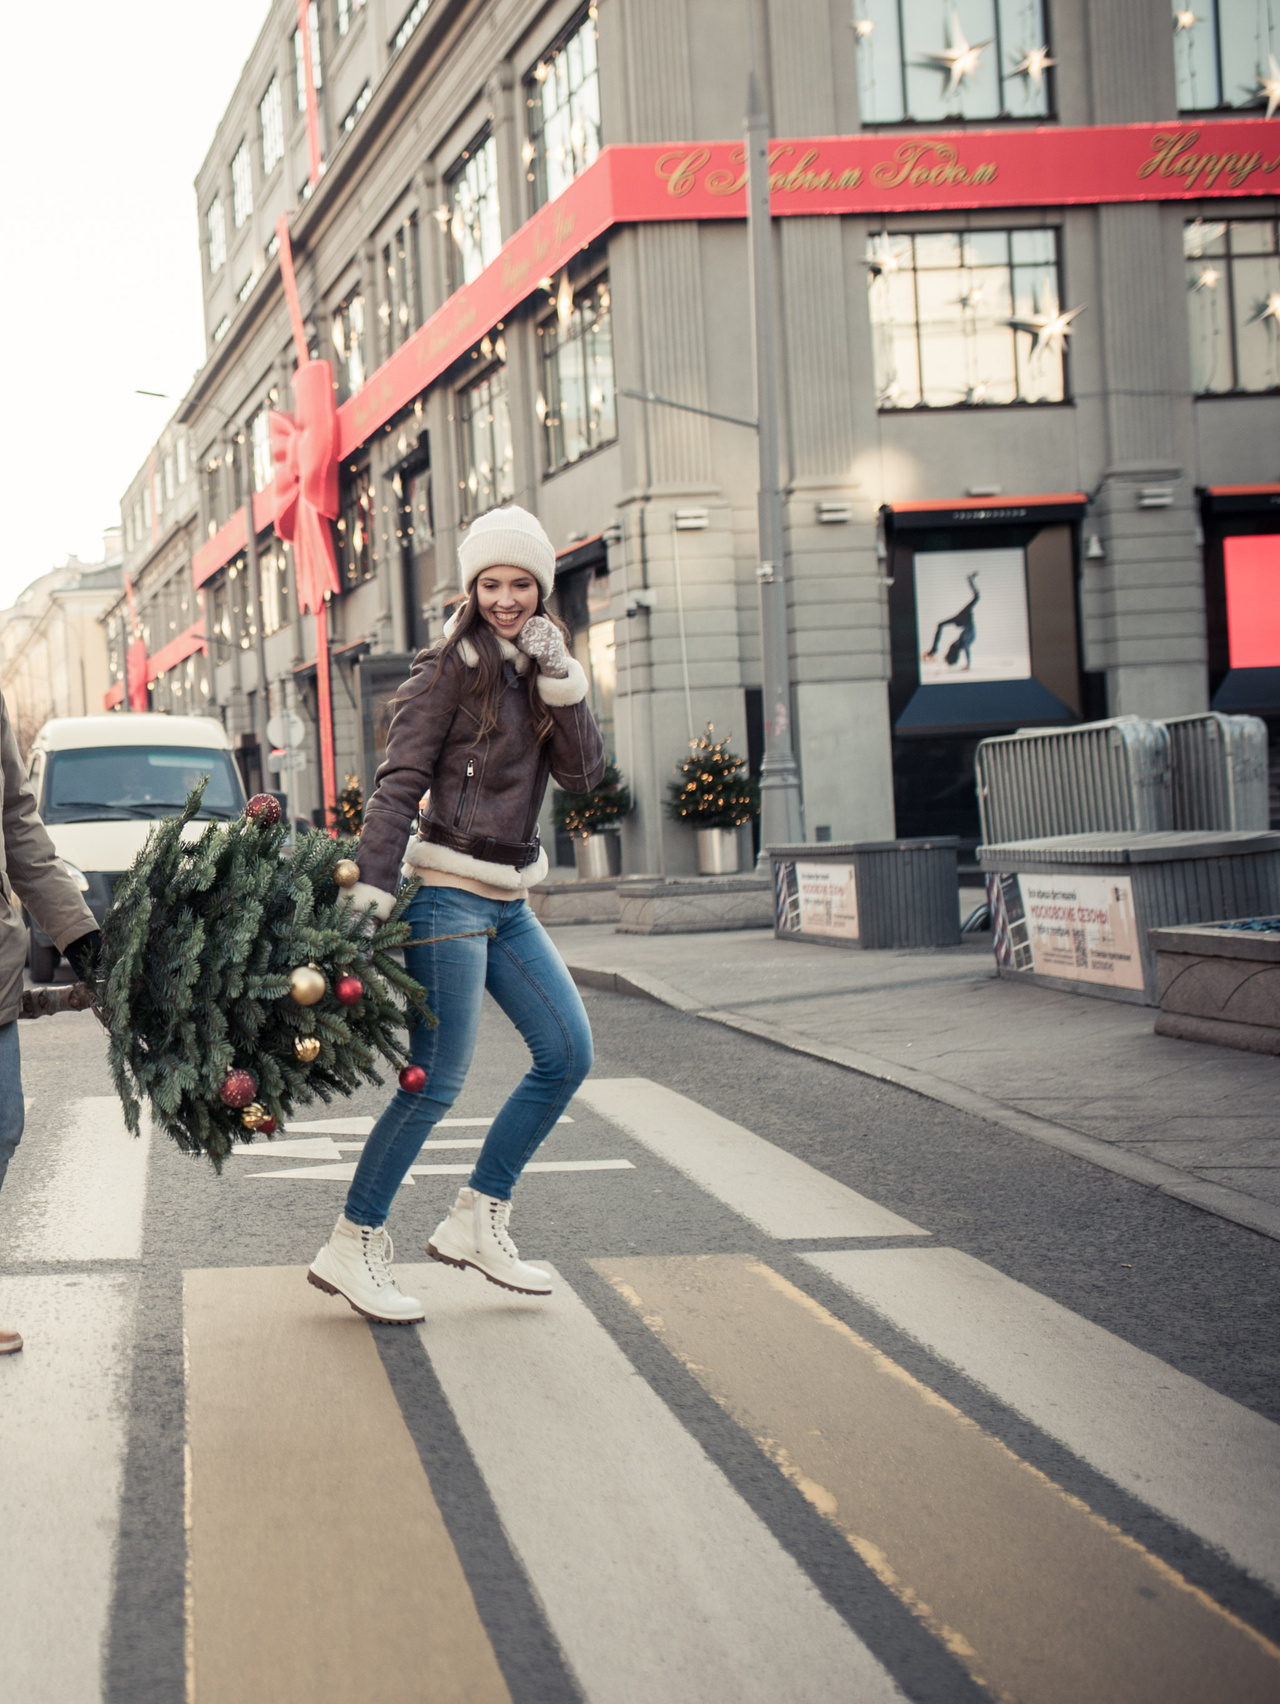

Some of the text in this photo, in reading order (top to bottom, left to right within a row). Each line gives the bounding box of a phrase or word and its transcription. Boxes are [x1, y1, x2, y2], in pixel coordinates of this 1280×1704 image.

[654, 148, 712, 198] С
[871, 139, 1000, 190] Годом
[1136, 129, 1263, 190] Happy
